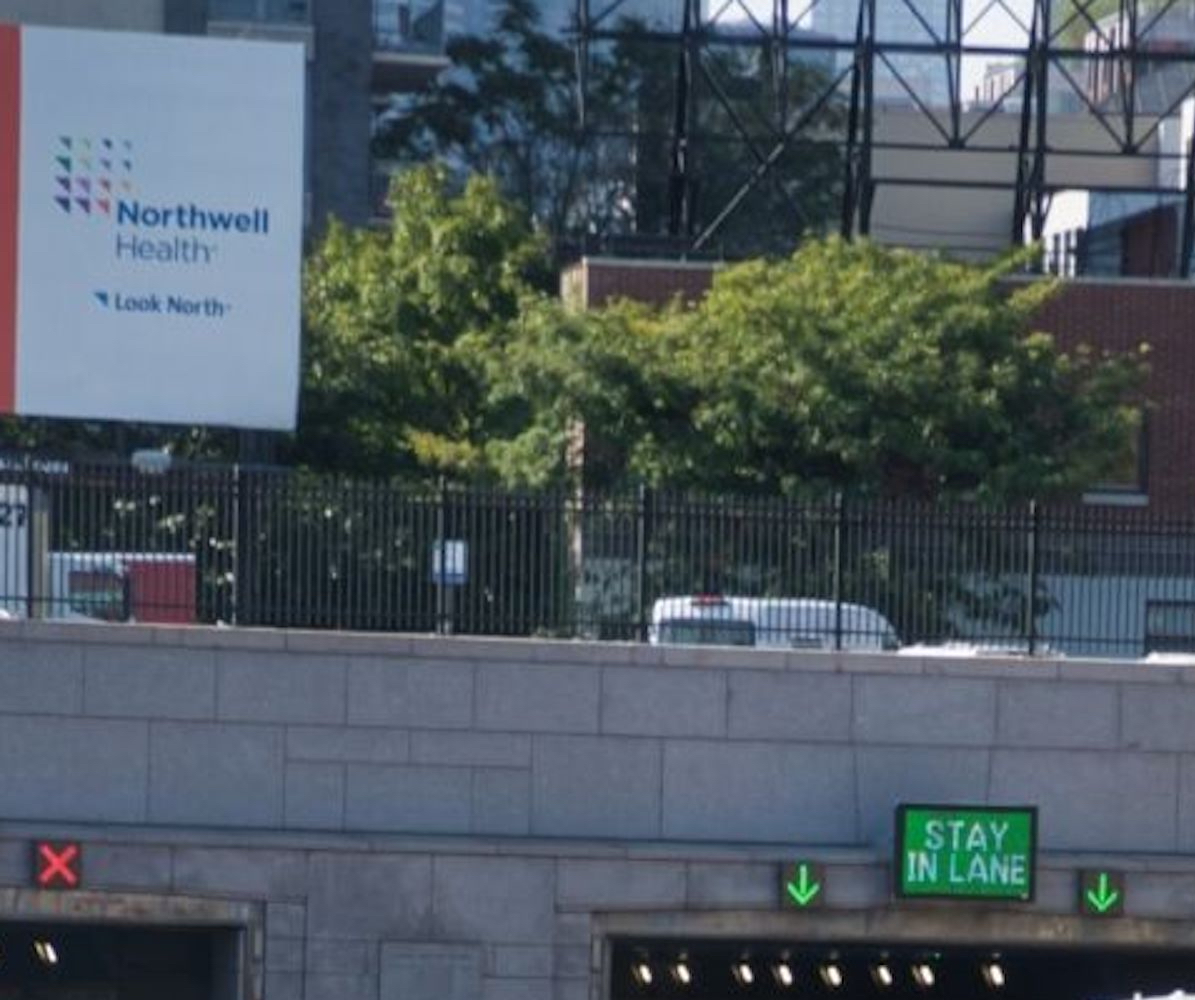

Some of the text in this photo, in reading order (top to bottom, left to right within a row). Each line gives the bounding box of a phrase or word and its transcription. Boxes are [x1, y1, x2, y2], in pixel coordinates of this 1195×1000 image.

[117, 200, 270, 234] Northwell
[116, 233, 211, 264] Health
[115, 293, 224, 317] Look North
[925, 820, 1009, 852] STAY
[907, 851, 1026, 885] IN LANE
